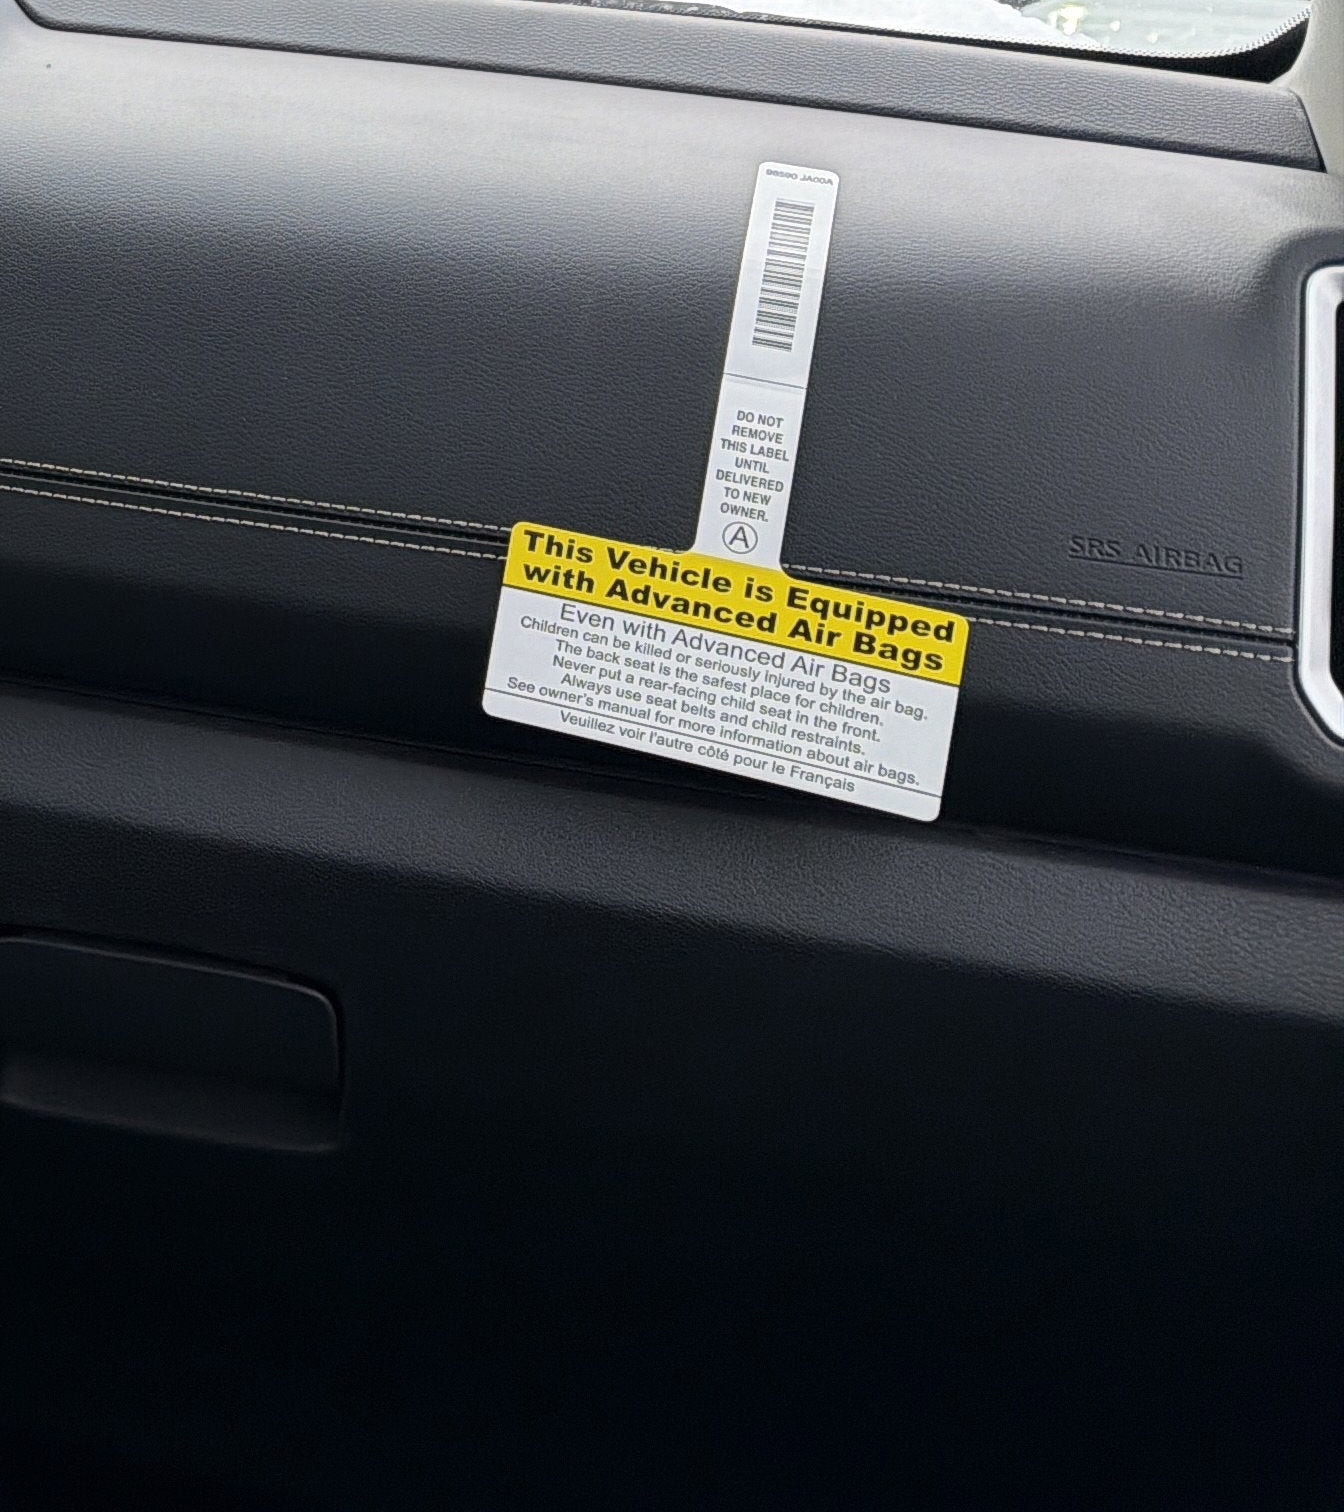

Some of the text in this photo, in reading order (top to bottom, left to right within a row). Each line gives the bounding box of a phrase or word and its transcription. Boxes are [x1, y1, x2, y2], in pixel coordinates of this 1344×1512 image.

[720, 438, 790, 462] THIS LABEL
[731, 424, 785, 445] REMOVE
[736, 409, 785, 429] DO NOT
[715, 468, 785, 493] DELIVERED
[723, 486, 772, 506] TO NEW
[734, 456, 770, 474] UNTIL
[720, 501, 769, 523] OWNER.
[523, 529, 956, 644] This Vehicle is Equipped
[1067, 534, 1244, 575] SRS AIRBAG
[523, 563, 945, 672] with Advanced Air Bags
[560, 602, 892, 695] Even with Advanced Air Bags
[520, 614, 929, 722] Children can be killed or seriously injured by the air bag.
[551, 653, 881, 743] Never put a rear-facing child seat in the front.
[555, 638, 884, 727] The back seat is the safest place for children.
[507, 675, 920, 787] See owner's manual for more information about air bags.
[559, 709, 857, 793] Veuillez voir l'autre côté pour le Français
[560, 672, 866, 756] Always use seat belts and child restraints.
